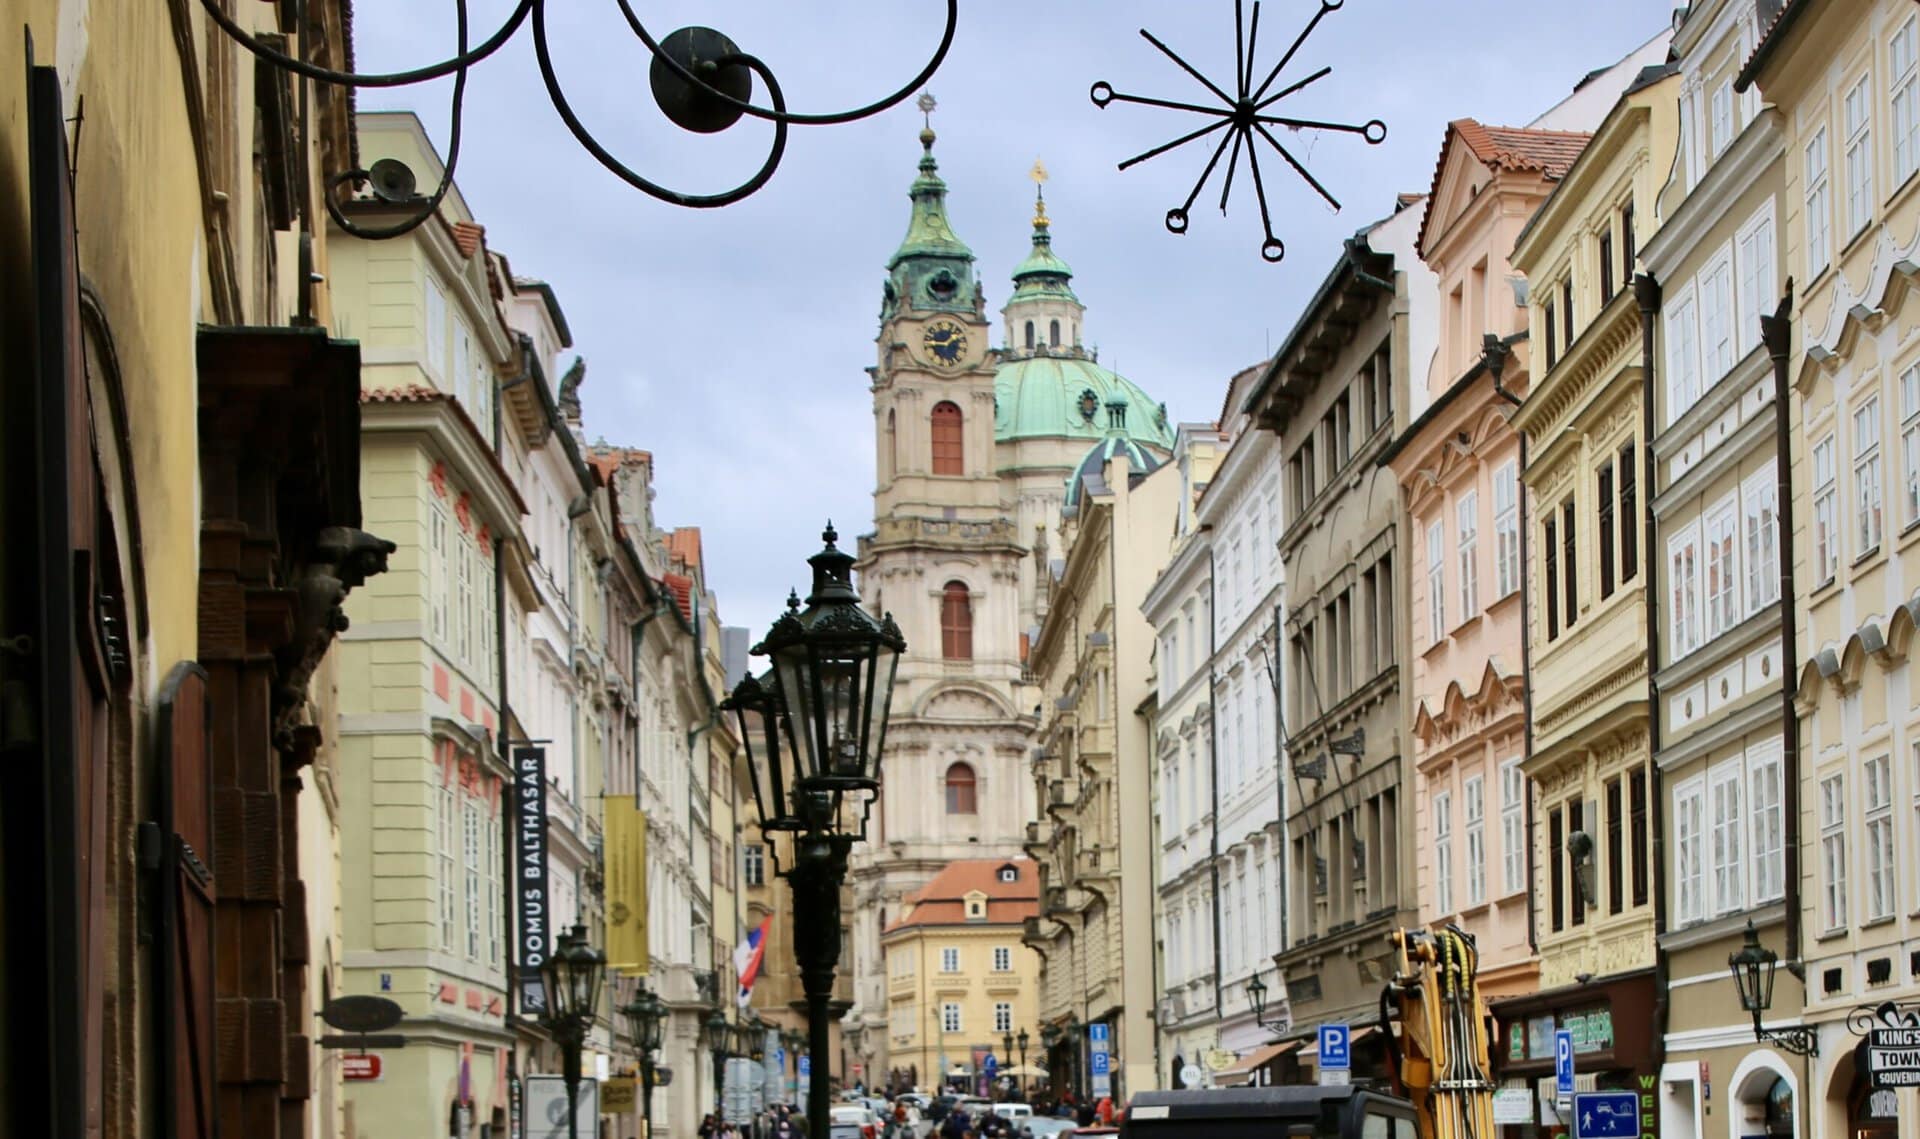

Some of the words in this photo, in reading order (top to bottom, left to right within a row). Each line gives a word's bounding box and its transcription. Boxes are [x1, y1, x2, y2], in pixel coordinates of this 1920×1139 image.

[522, 758, 541, 879] BALTHASAR
[526, 888, 543, 967] DOMUS
[1324, 1029, 1343, 1056] P
[1878, 1029, 1920, 1046] KING'S
[1558, 1037, 1569, 1075] P
[1879, 1051, 1920, 1067] TOWN
